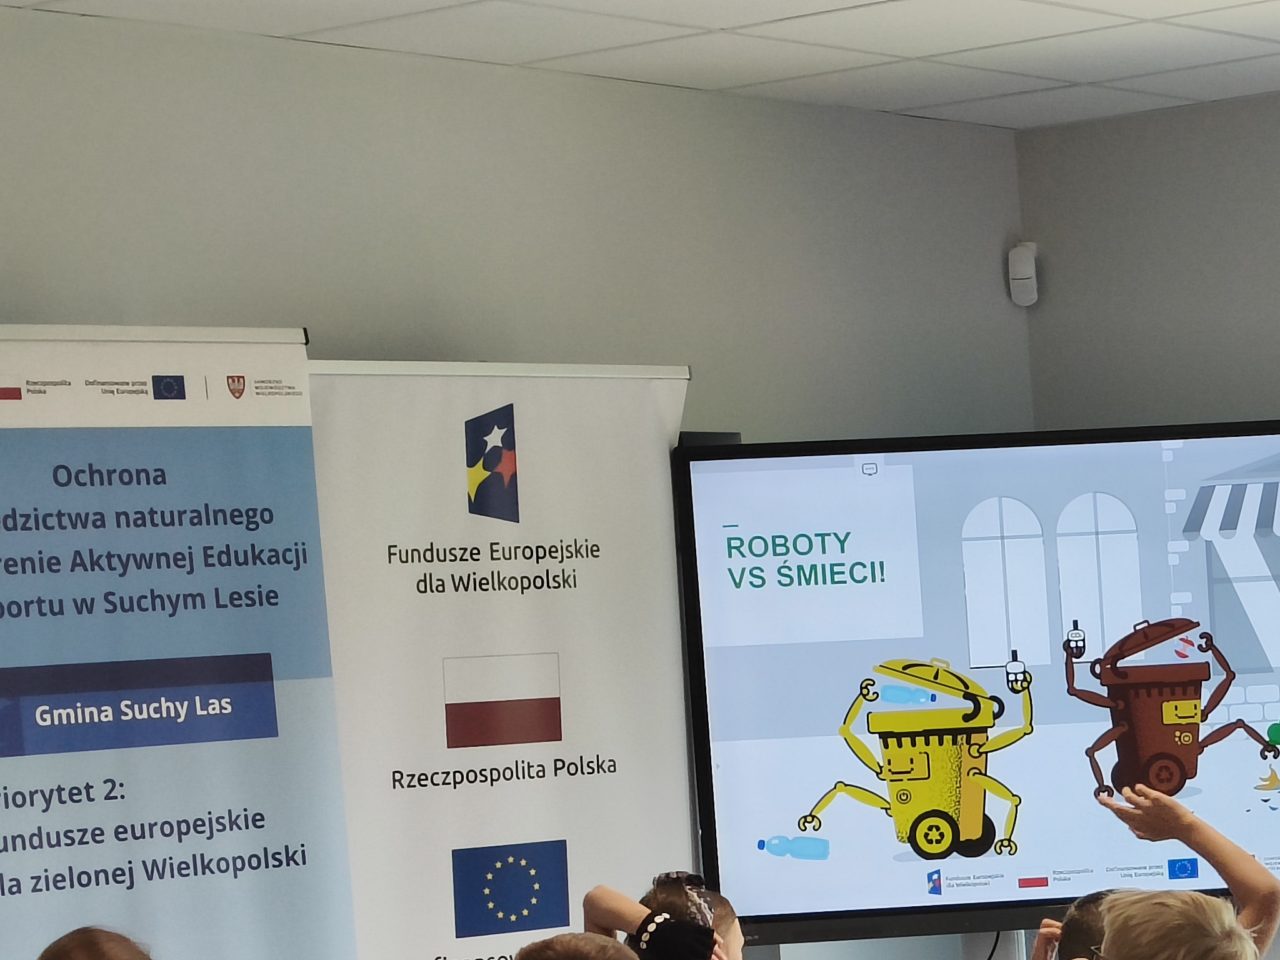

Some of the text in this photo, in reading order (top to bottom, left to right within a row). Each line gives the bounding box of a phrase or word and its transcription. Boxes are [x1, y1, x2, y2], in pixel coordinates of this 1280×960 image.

[52, 463, 167, 487] Ochrona
[0, 503, 274, 531] dzictwa naturalnego
[0, 542, 308, 577] enie Aktywnej Edukacji
[387, 539, 601, 564] Fundusze Europejskie
[726, 532, 851, 558] ROBOTY
[416, 569, 577, 594] dla Wielkopolski
[727, 560, 885, 589] VS ŚMIECI!
[73, 596, 95, 614] w
[104, 589, 206, 618] Suchym
[214, 584, 279, 609] Lesie
[35, 694, 232, 726] Gmina Suchy Las
[392, 755, 617, 789] Rzeczpospolita Polska
[0, 778, 126, 813] iorytet 2:
[114, 808, 266, 843] europejskie
[30, 860, 135, 894] zielonej
[142, 844, 308, 882] Wielkopolski
